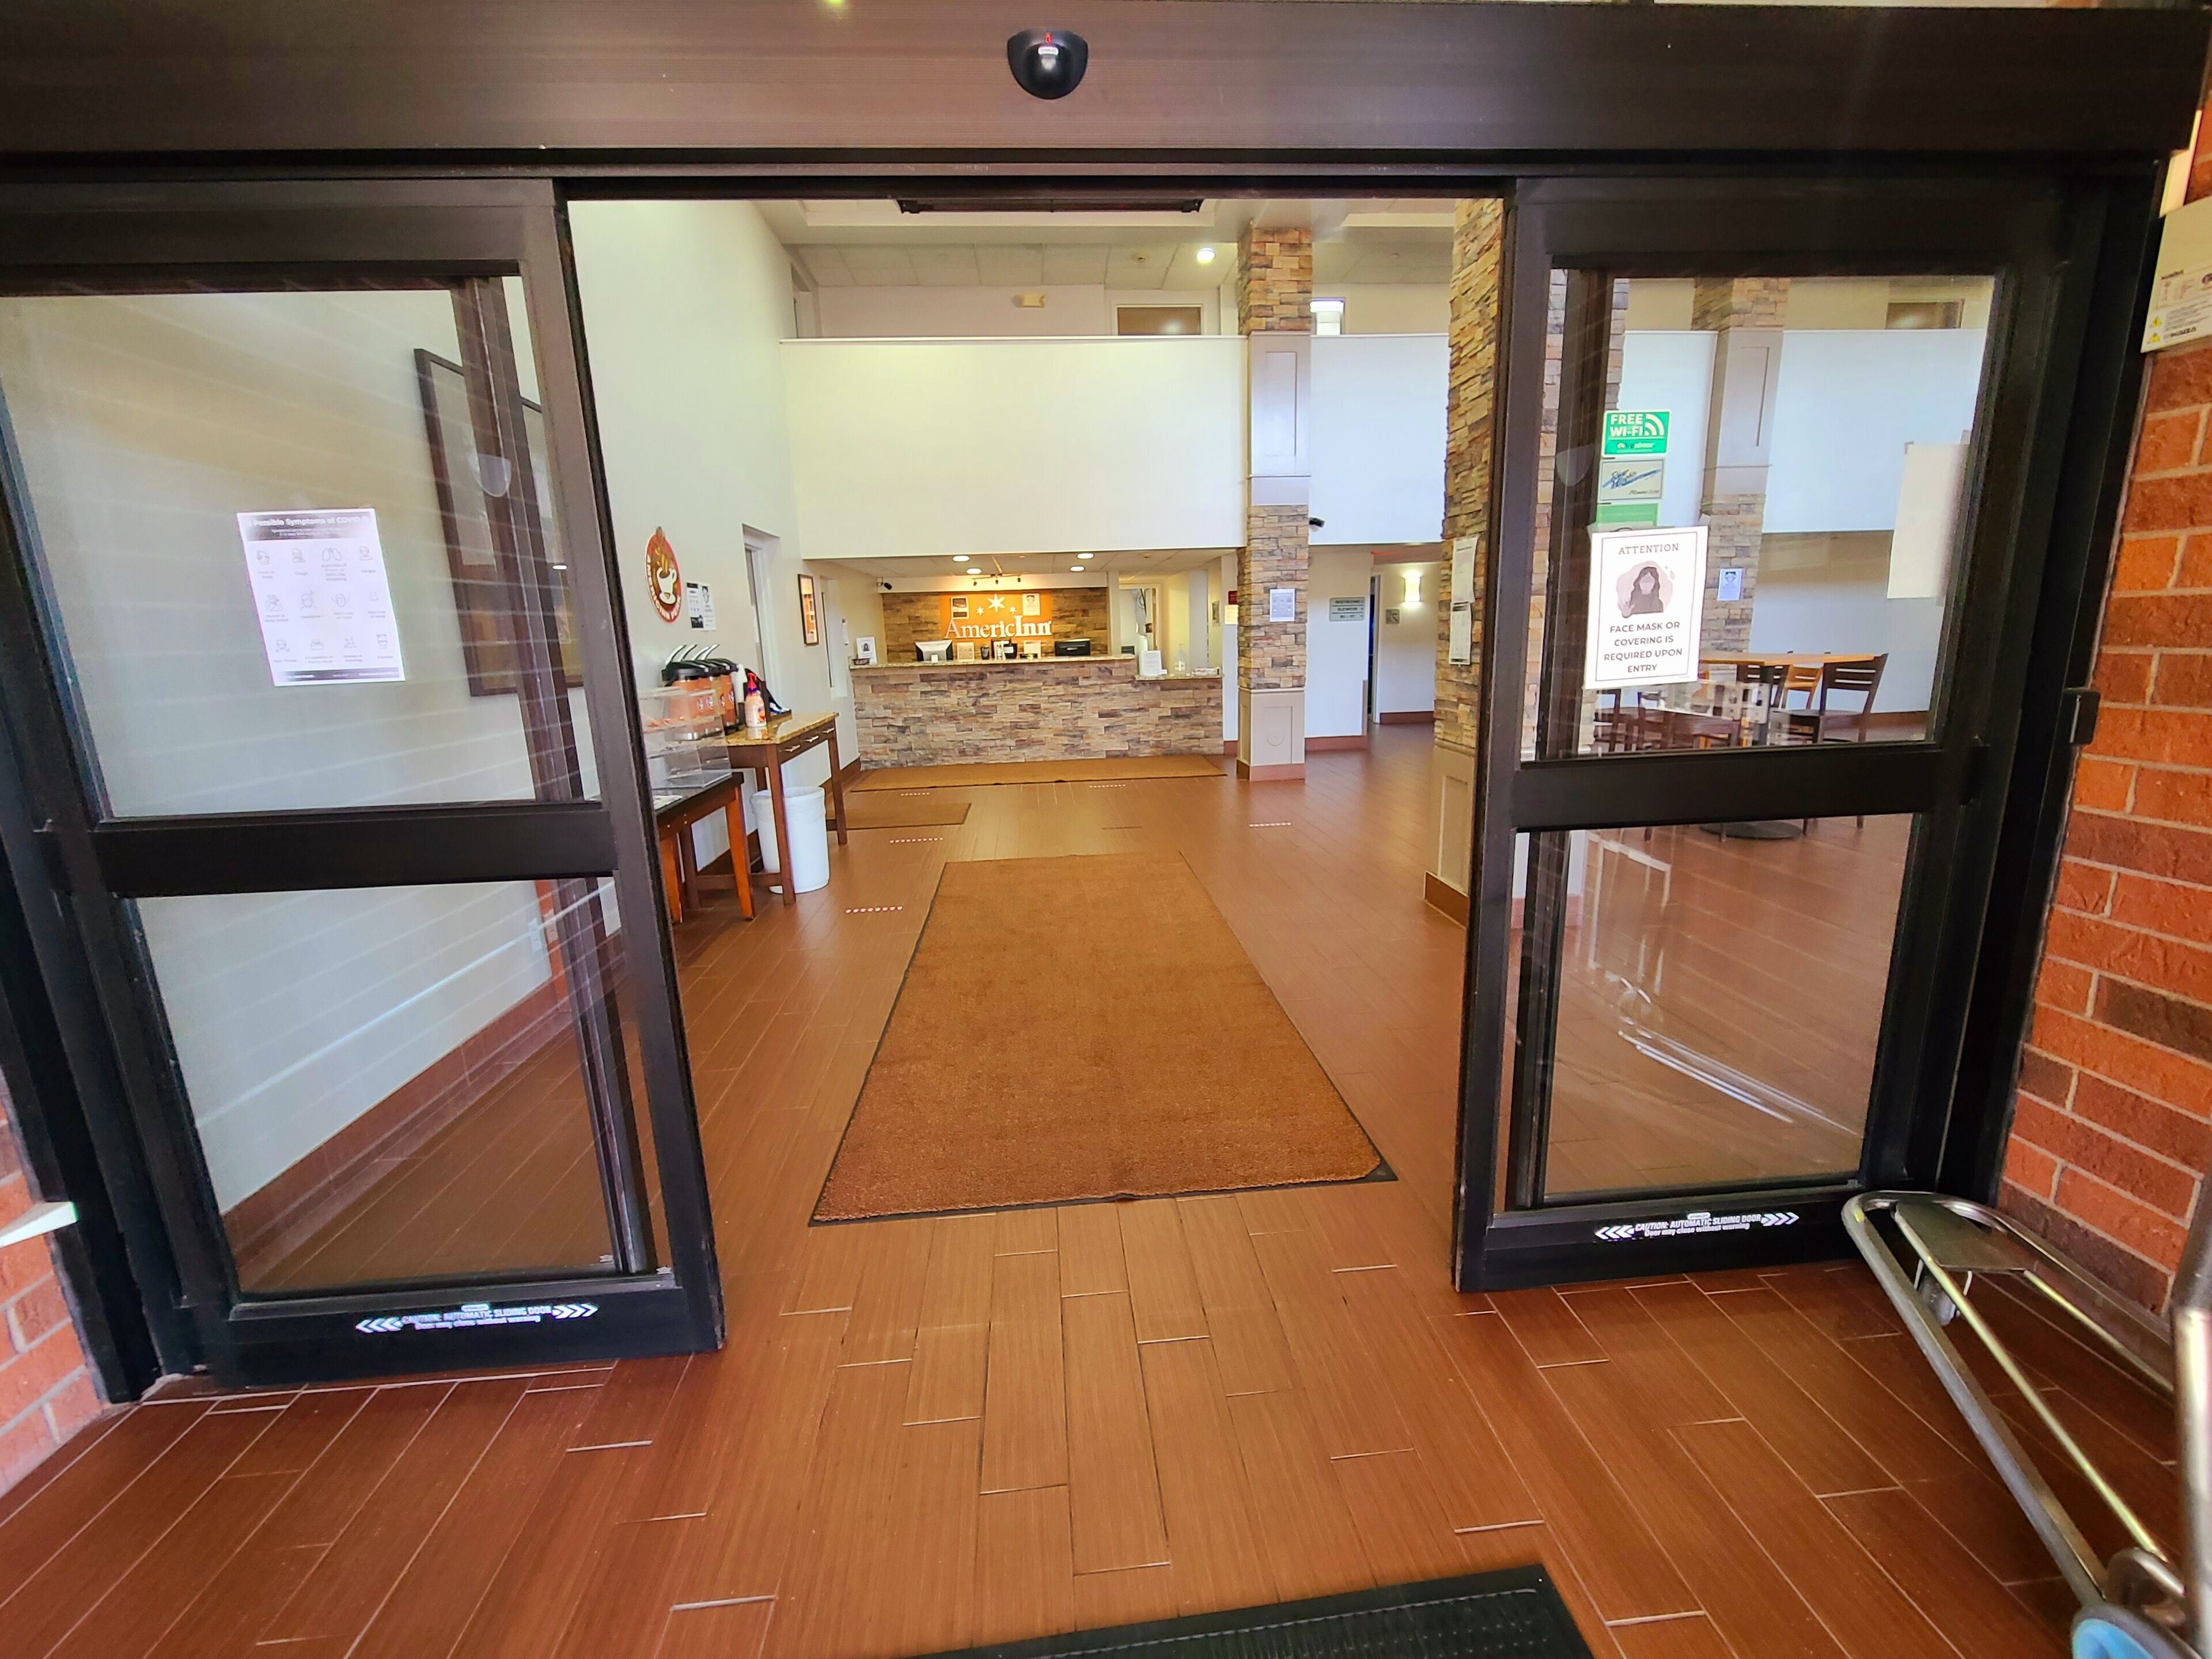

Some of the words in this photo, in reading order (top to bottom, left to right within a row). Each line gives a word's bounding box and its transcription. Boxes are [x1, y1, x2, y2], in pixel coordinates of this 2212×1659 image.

[1611, 414, 1643, 425] FREE
[1610, 426, 1643, 437] WI-FI
[1618, 543, 1679, 555] ATTENTION
[943, 615, 1052, 639] AmericInn
[1610, 624, 1634, 632] FACE
[1637, 623, 1663, 631] MASK
[1614, 637, 1662, 646] COVERING
[1604, 650, 1652, 661] REQUIRED
[1655, 649, 1682, 657] UPON
[1627, 664, 1657, 673] ENTRY
[1635, 1221, 1669, 1231] CAUTION:
[1669, 1218, 1711, 1228] AUTOMATIC
[1713, 1215, 1740, 1225] SLIDING
[1741, 1214, 1762, 1222] DOOR
[1645, 1229, 1661, 1237] Door
[443, 1310, 493, 1321] AUTOMATIC
